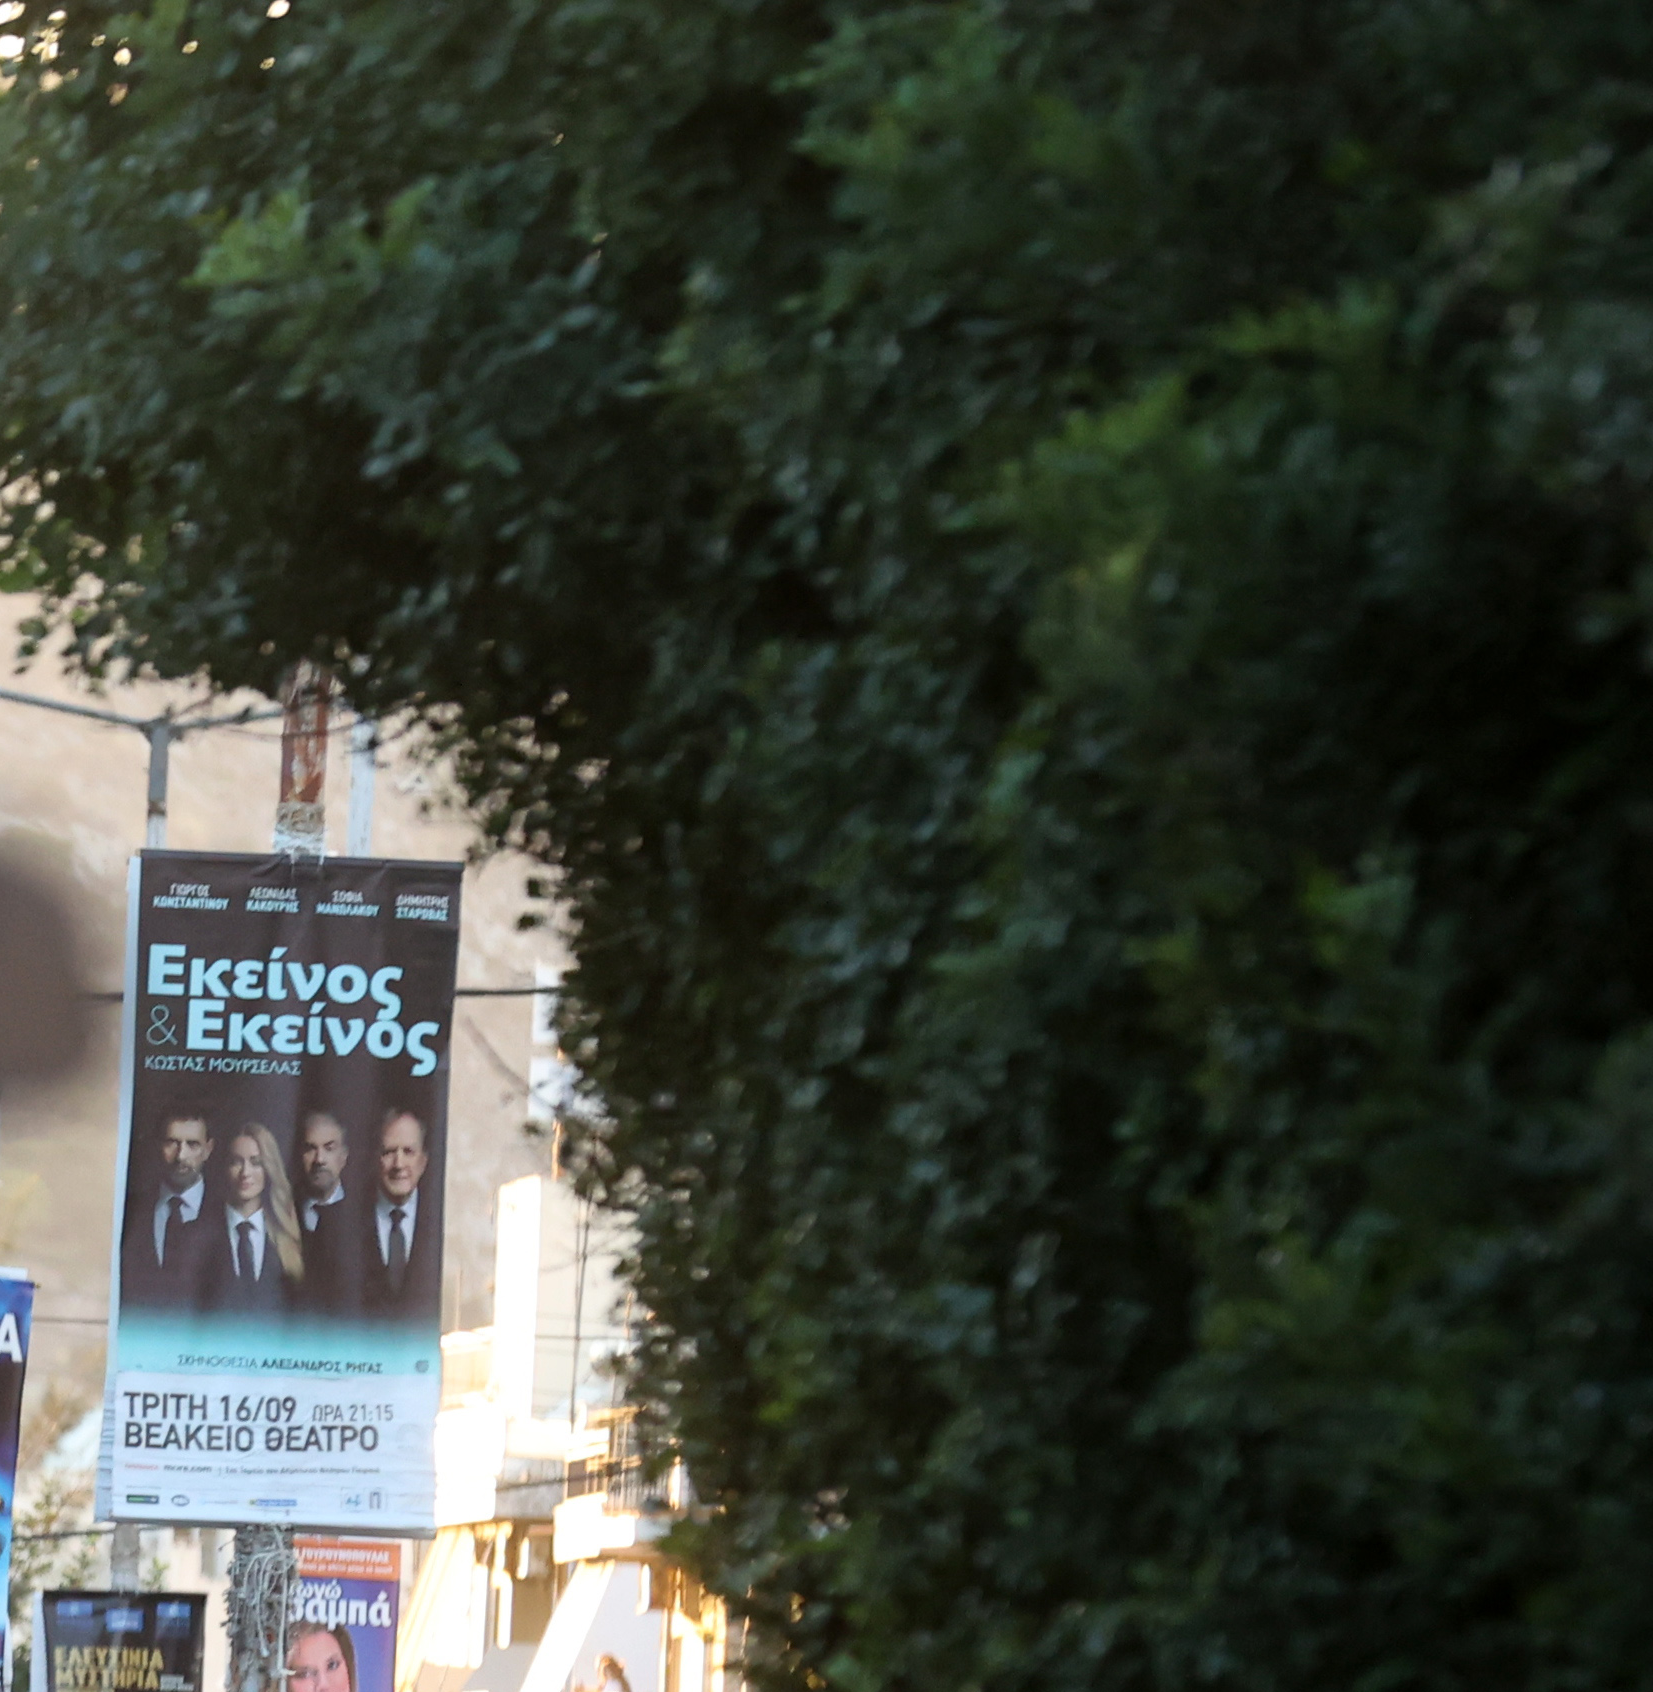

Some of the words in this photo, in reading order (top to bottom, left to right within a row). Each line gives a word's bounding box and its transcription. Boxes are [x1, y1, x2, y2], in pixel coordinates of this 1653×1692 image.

[147, 943, 404, 1021] Εκείνος
[146, 1004, 179, 1046] &
[186, 998, 441, 1077] Εκείνος
[144, 1055, 205, 1072] ΚΩΣΤΑΣ
[209, 1057, 302, 1075] ΜΟΥΡΣΕΛΑΣ
[178, 1354, 258, 1369] ΣΚΗΝΟΘΕΣΙΑ
[261, 1358, 342, 1372] ΑΛΕΞΑΝΔΡΟΣ
[345, 1362, 383, 1374] ΡΗΓΑΣ
[124, 1391, 208, 1421] ΤΡΙΤΗ
[219, 1394, 297, 1423] 16/09
[312, 1404, 344, 1422] ΩΡΑ
[349, 1404, 394, 1422] 21:15
[124, 1422, 255, 1452] ΒΕΑΚΕΙΟ
[264, 1425, 380, 1452] ΘΕΑΤΡΟ
[291, 1578, 343, 1600] ωγώ
